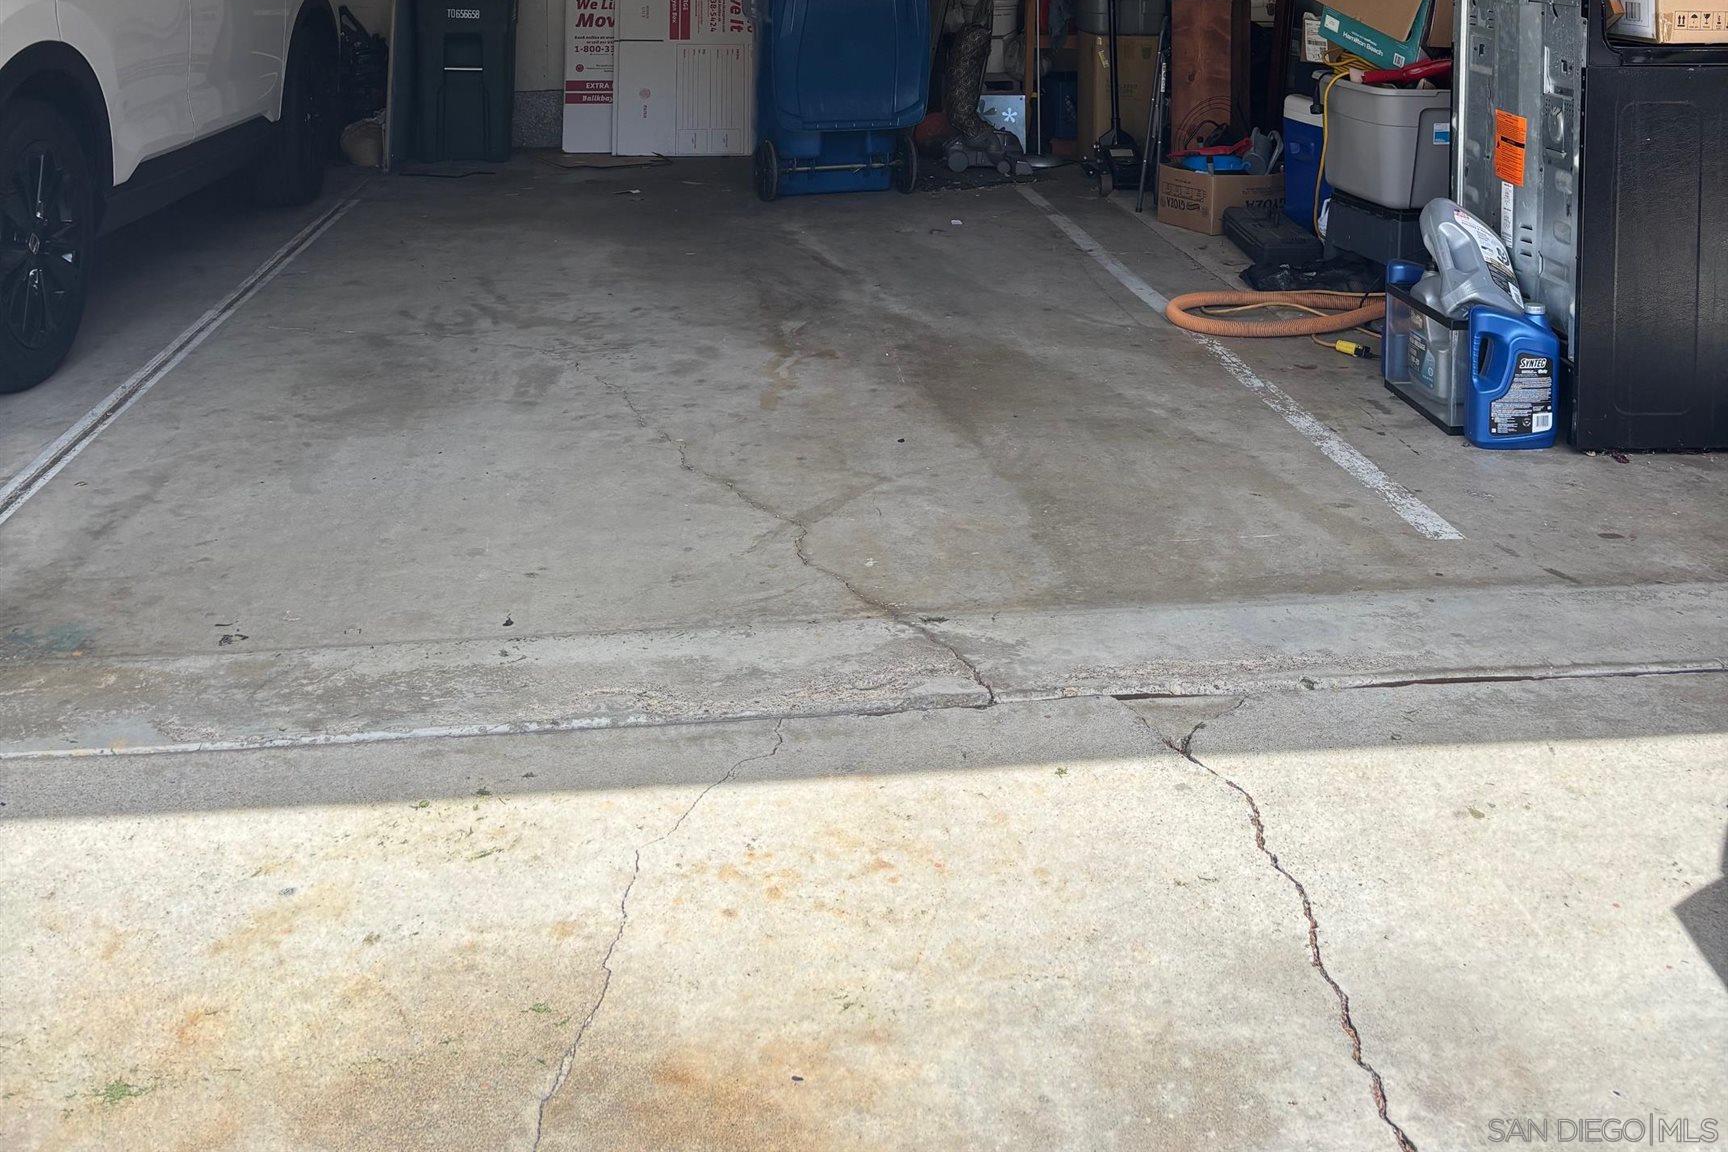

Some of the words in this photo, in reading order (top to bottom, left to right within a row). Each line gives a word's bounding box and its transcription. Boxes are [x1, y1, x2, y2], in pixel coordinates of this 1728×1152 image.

[575, 13, 615, 28] Mov
[671, 13, 679, 24] Box
[730, 19, 744, 33] It
[574, 44, 615, 53] 1-800-33
[1342, 31, 1367, 48] Hamilton
[1366, 42, 1384, 57] Beach
[582, 94, 613, 103] Balikbay
[1520, 357, 1547, 369] SYNTEC
